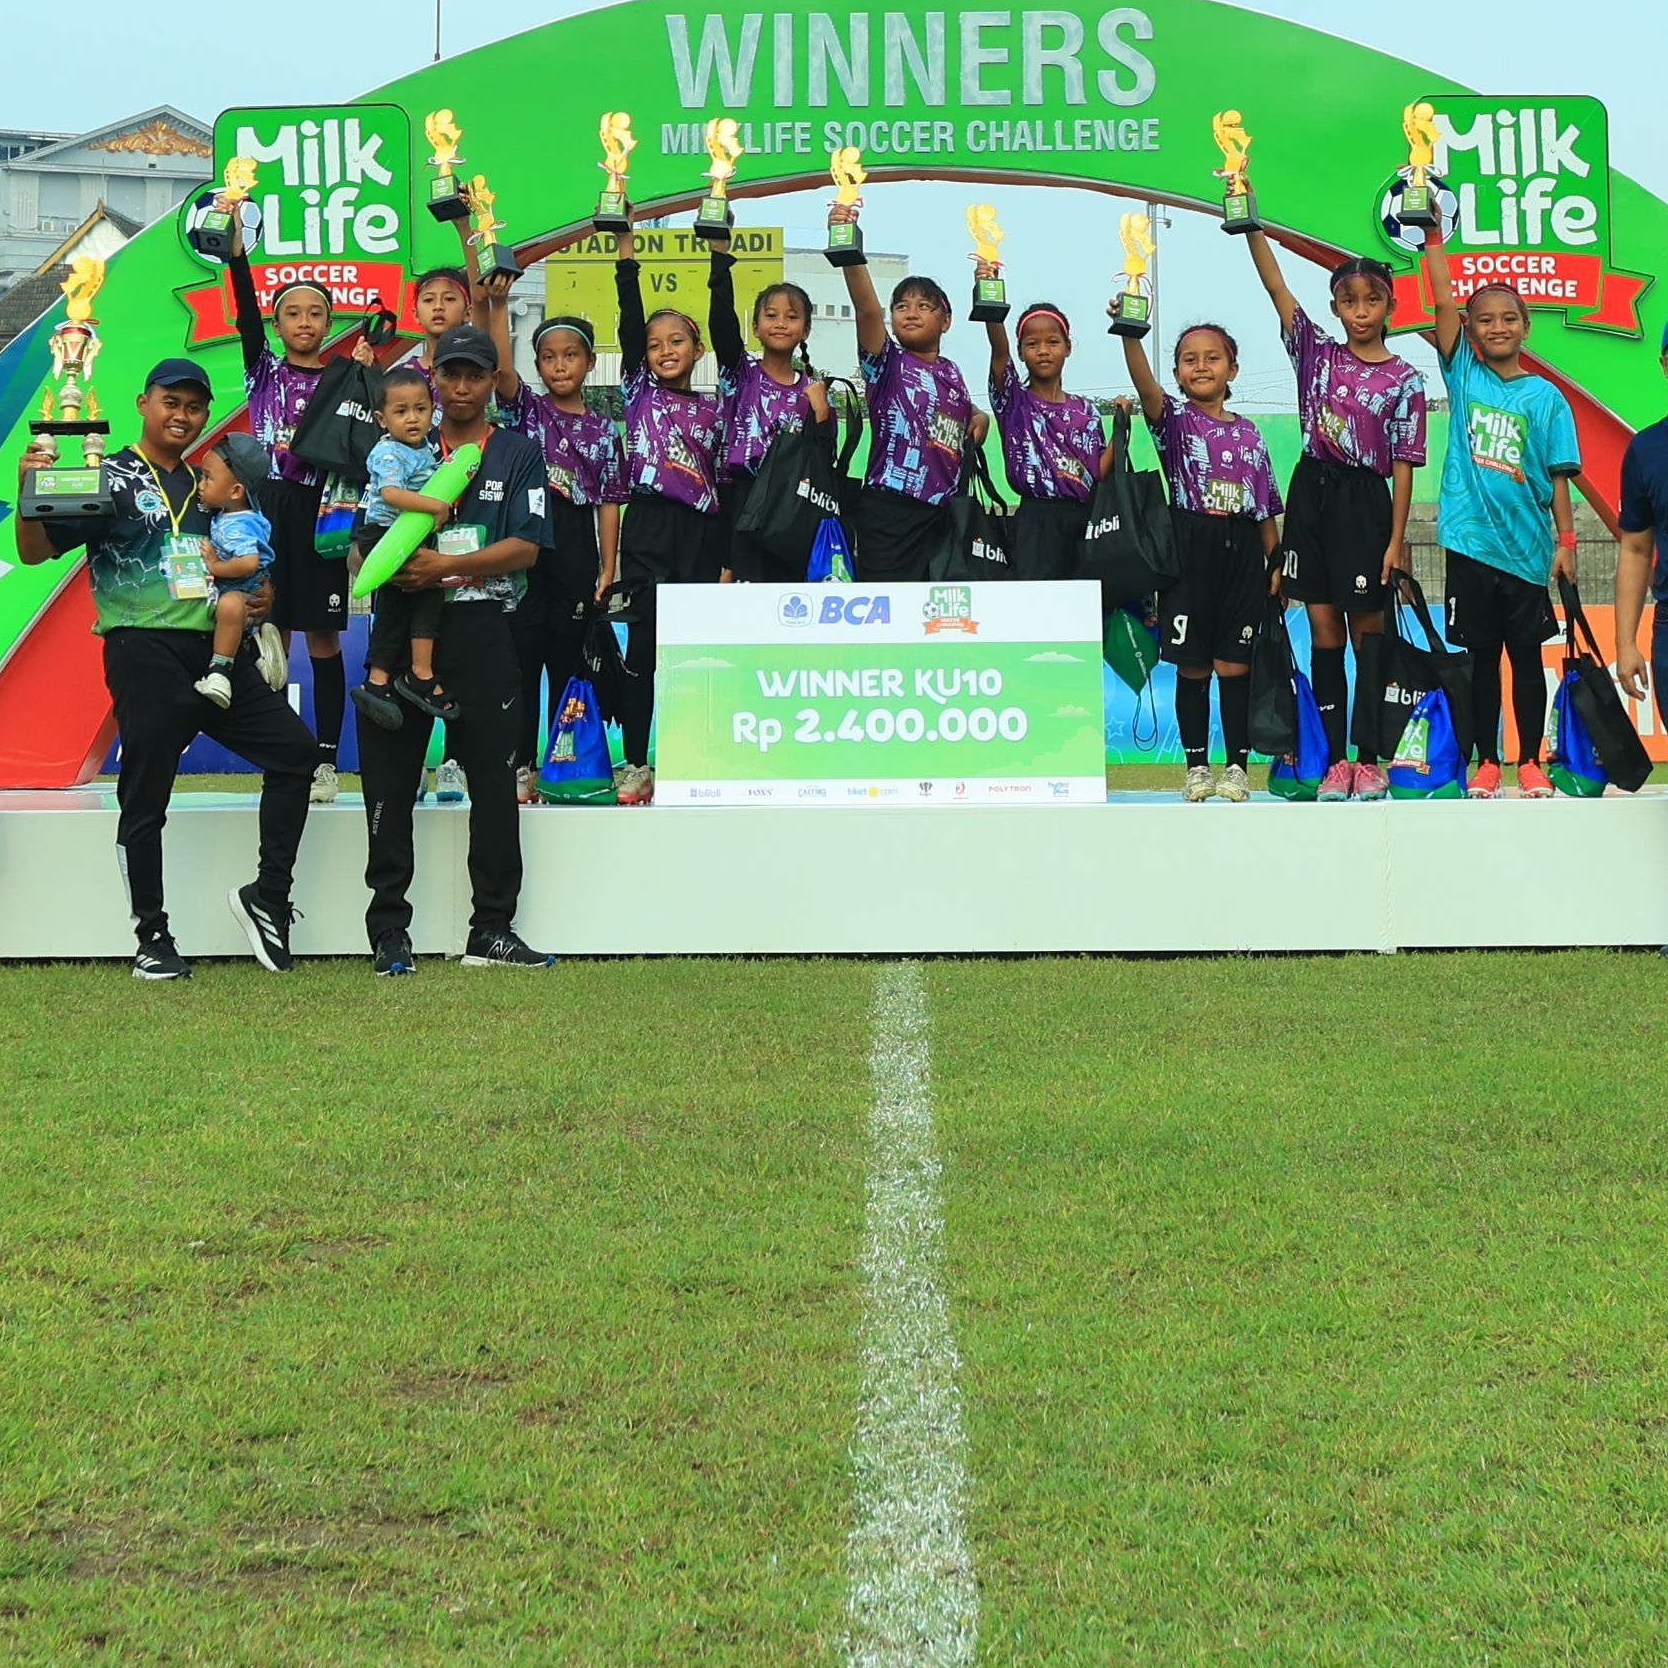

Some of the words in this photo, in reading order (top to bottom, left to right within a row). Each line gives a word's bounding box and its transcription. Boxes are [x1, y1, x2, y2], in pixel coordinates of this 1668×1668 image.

[665, 8, 1156, 108] WINNERS
[661, 122, 812, 154] MILIFE
[823, 120, 955, 153] SOCCER
[966, 118, 1160, 151] CHALLENGE
[1433, 108, 1591, 179] Milk
[236, 118, 393, 188] Milk
[263, 187, 400, 255] Life
[1459, 178, 1598, 246] Life
[558, 235, 663, 254] TADON
[674, 234, 772, 253] TRADI
[264, 266, 358, 285] SOCCER
[1461, 256, 1556, 275] SOCCER
[650, 273, 677, 293] VS
[937, 415, 960, 437] Milk
[1471, 408, 1522, 443] Milk
[937, 430, 959, 450] Life
[1475, 434, 1521, 464] Life
[485, 480, 503, 491] POR
[1212, 481, 1240, 499] Milk
[1215, 497, 1241, 514] Life
[934, 587, 968, 603] Milk
[819, 596, 891, 625] BCA
[940, 602, 969, 617] Life
[756, 668, 904, 698] WINNER
[915, 668, 1003, 705] KU10
[733, 711, 782, 752] Rp
[794, 707, 1028, 744] 2.400.000
[988, 785, 1032, 793] POLYTRON
